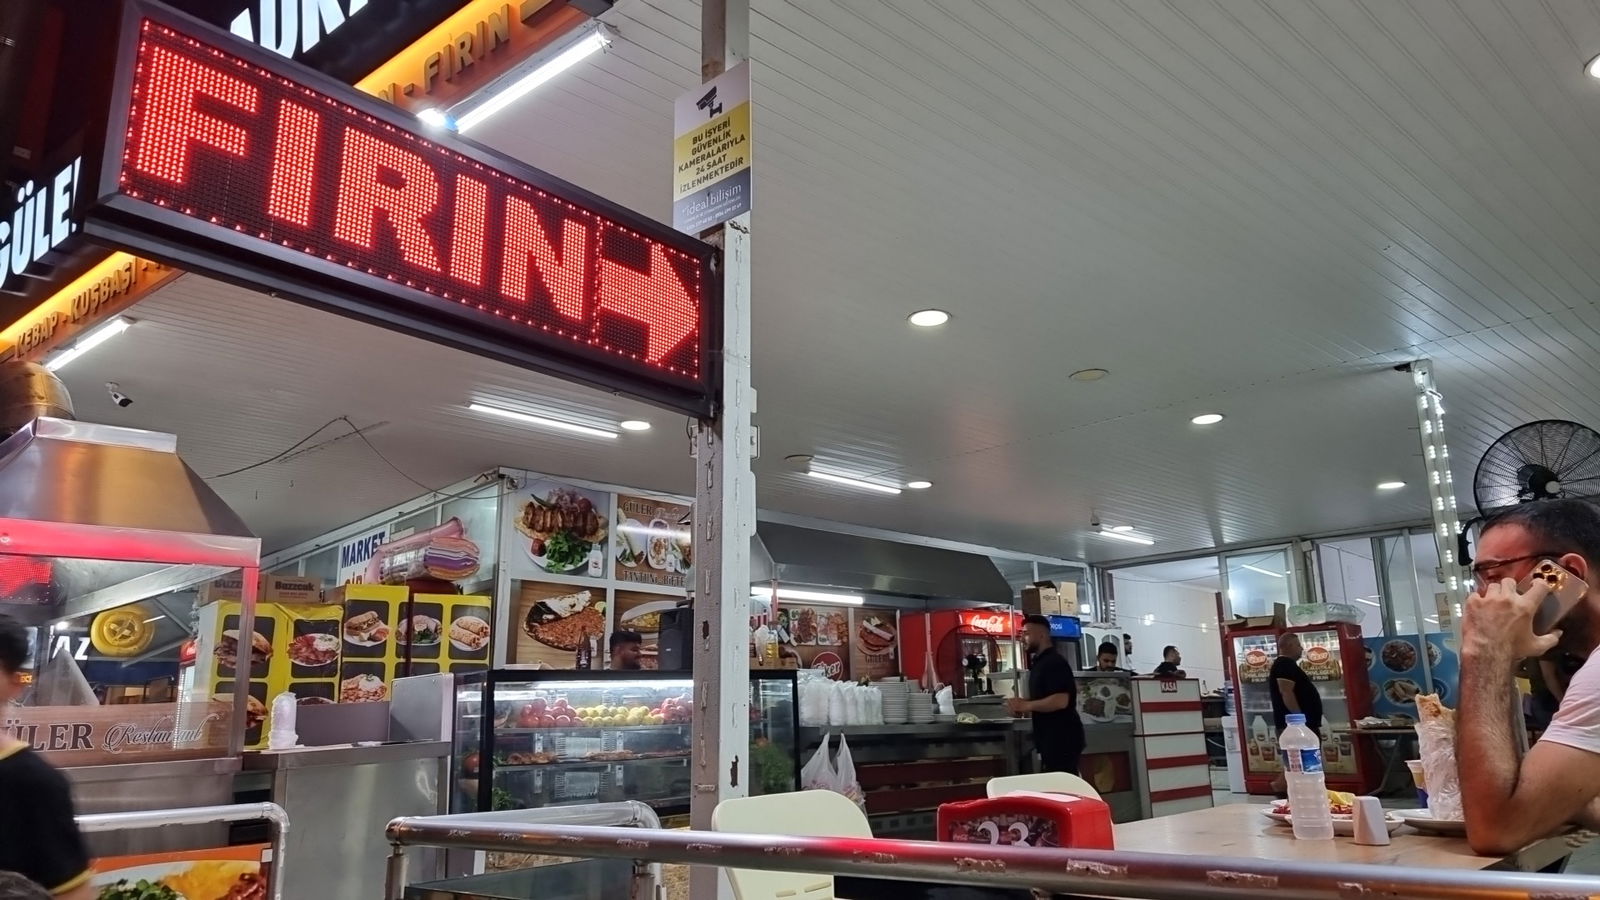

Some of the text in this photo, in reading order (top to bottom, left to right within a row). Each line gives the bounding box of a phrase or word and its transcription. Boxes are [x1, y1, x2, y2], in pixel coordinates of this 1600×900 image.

[424, 4, 510, 94] FIRIN
[691, 129, 731, 156] GÜVENLİK
[692, 117, 731, 145] BU İŞYERİ
[678, 133, 745, 173] KAMERALARIYLA
[695, 153, 727, 176] 24 SAAT
[137, 46, 586, 321] FIRIN
[680, 156, 744, 194] İZLENMEKTEDİR
[15, 311, 60, 358] KEBAP
[71, 257, 137, 324] KUŞBAŞI
